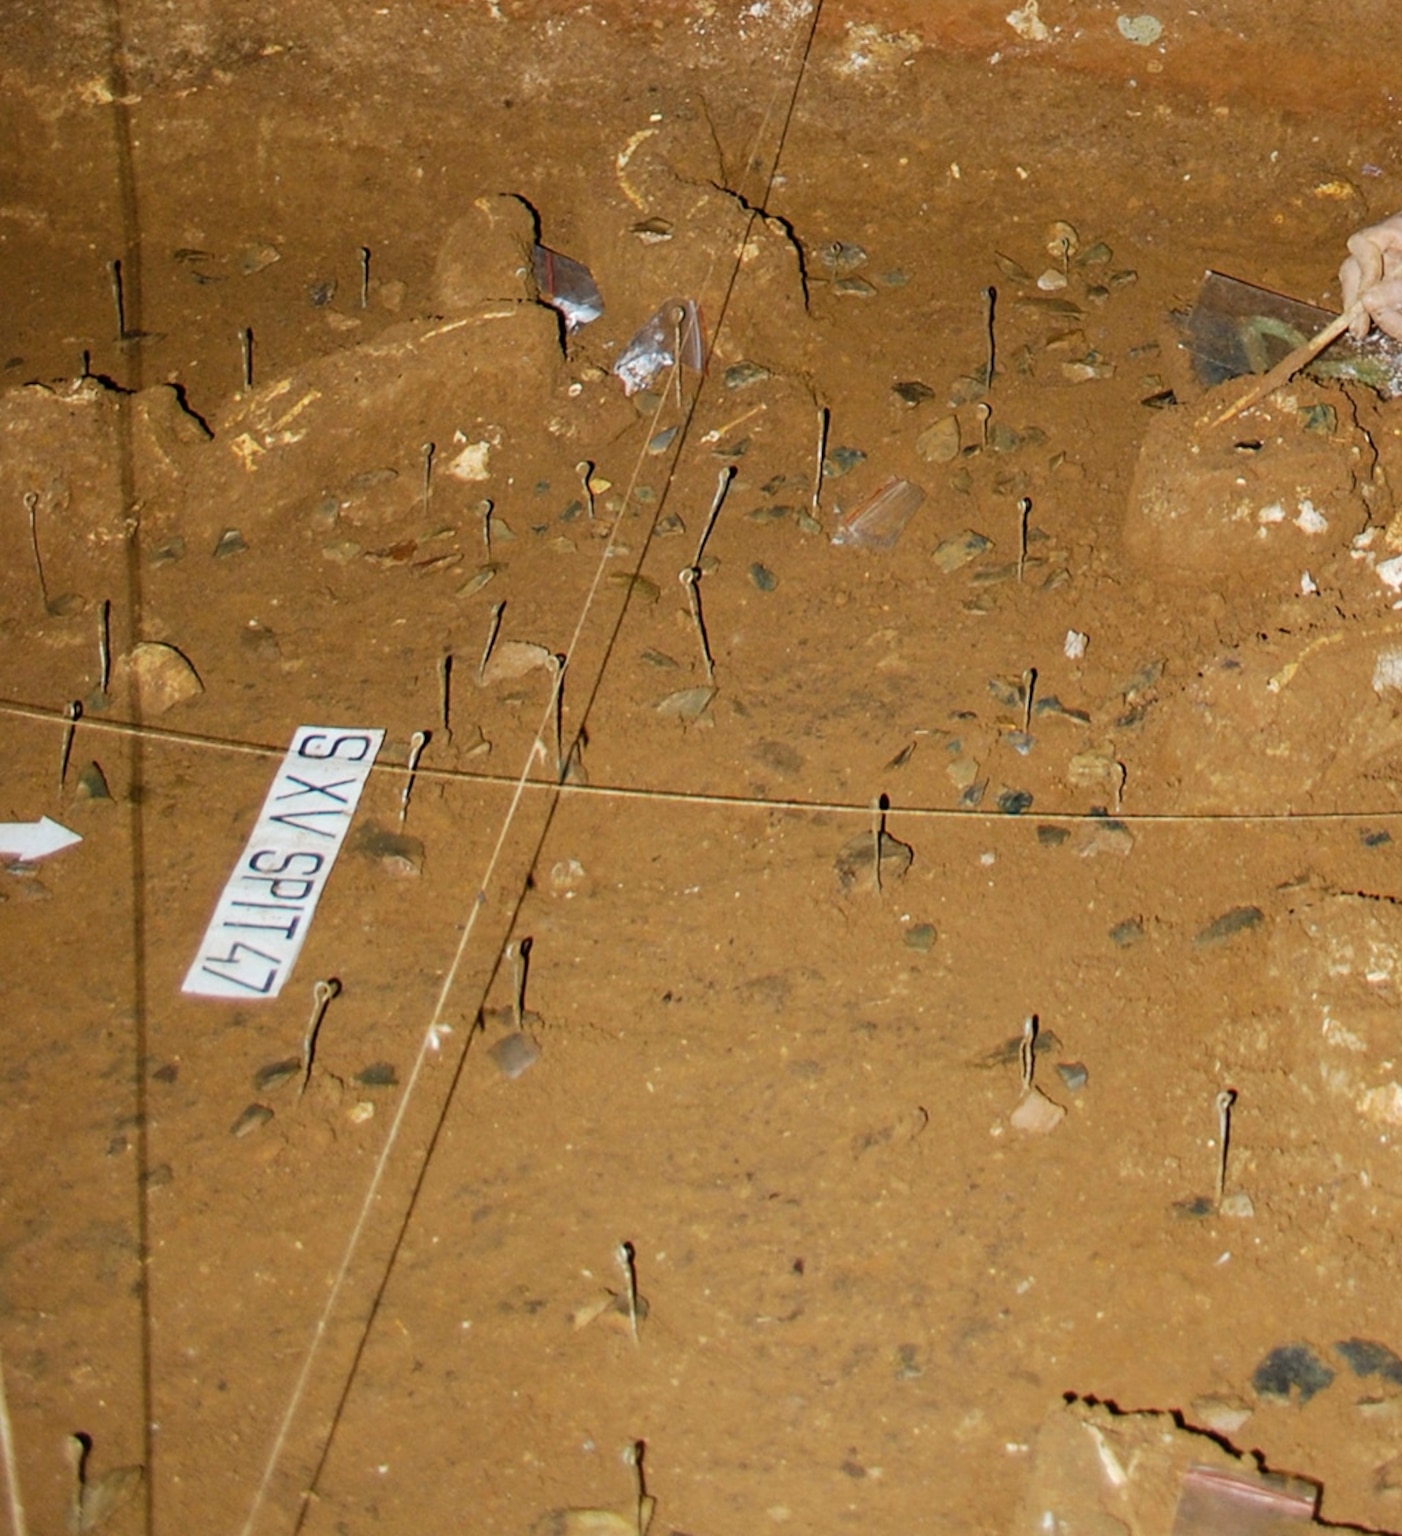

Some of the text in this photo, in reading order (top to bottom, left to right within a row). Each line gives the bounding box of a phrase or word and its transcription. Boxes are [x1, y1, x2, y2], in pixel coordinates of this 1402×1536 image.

[202, 734, 372, 994] S XV SPIT 47
